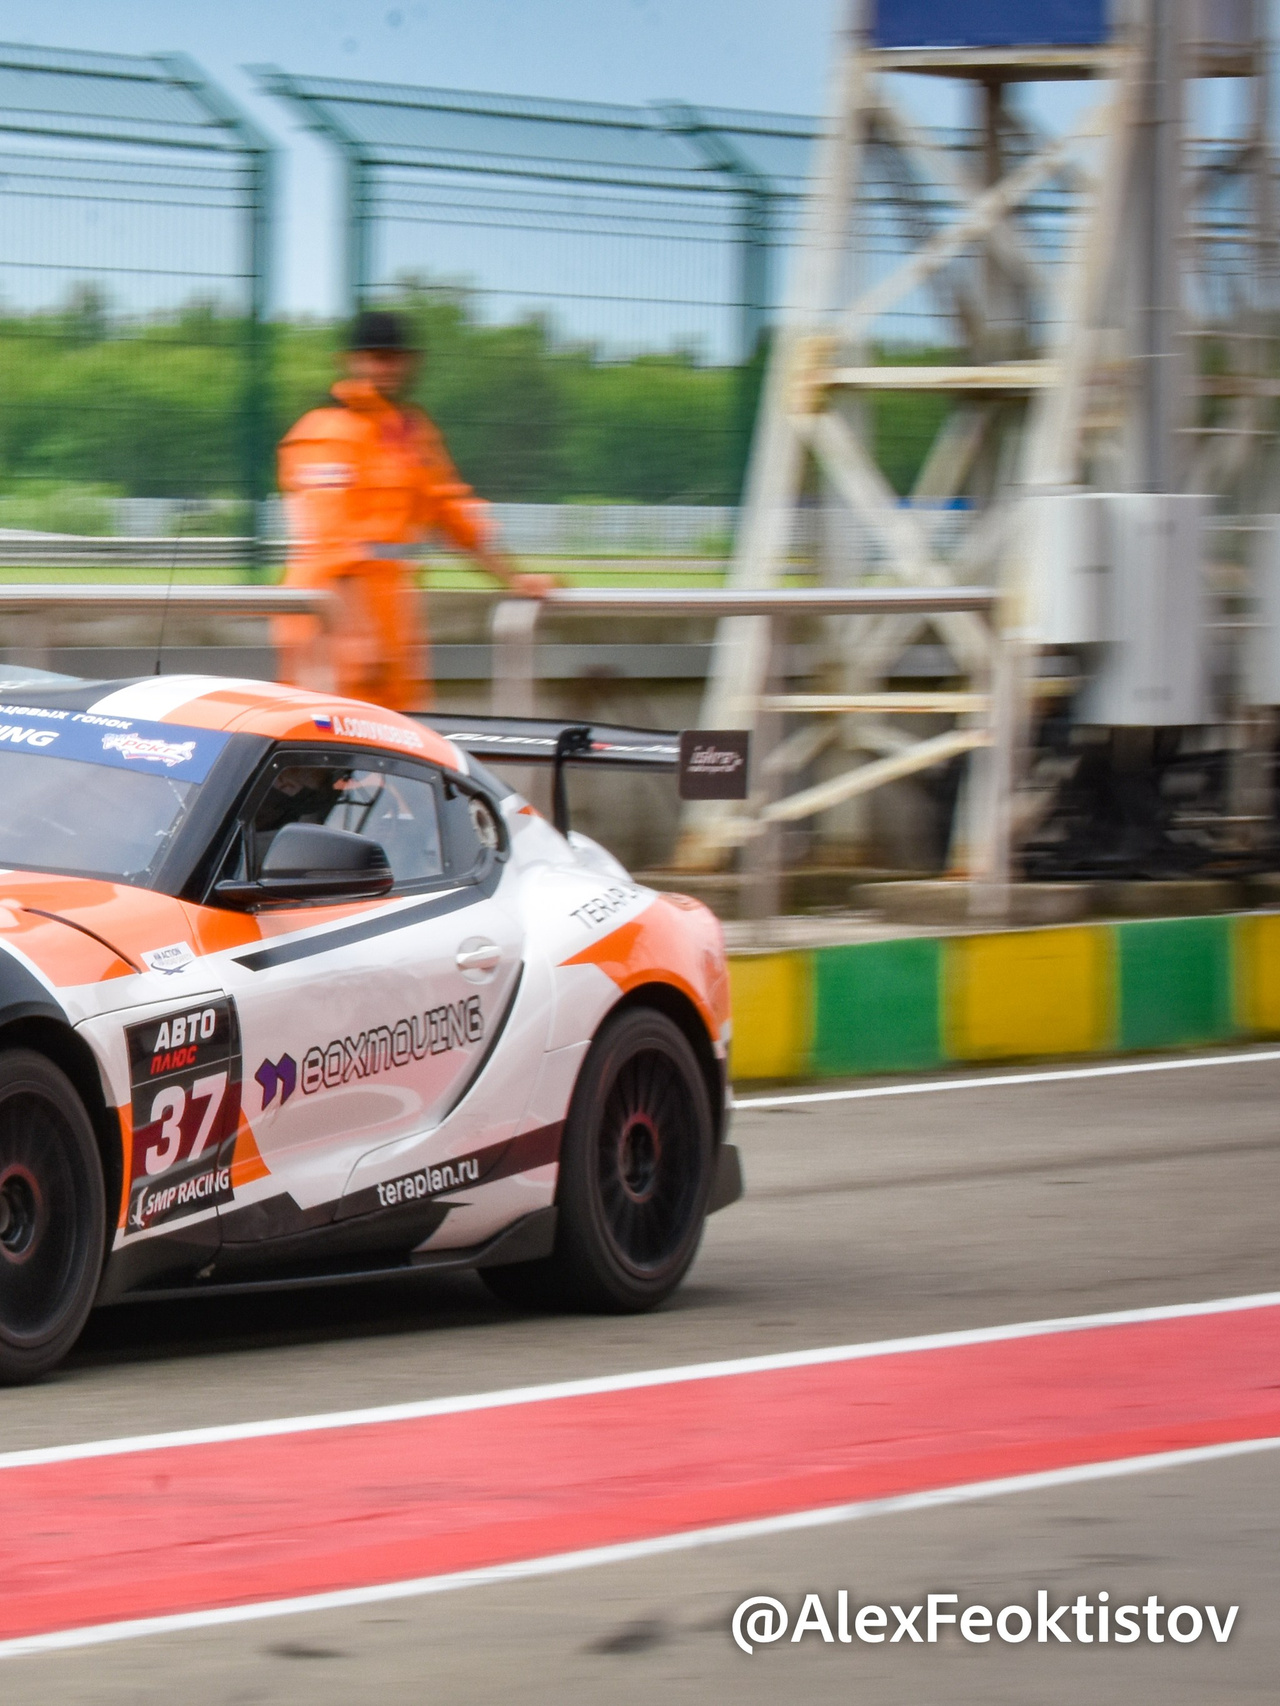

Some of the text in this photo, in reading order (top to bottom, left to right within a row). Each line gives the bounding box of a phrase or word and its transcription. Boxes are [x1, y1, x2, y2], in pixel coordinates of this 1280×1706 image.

[154, 1008, 216, 1053] АВТО
[150, 1045, 198, 1075] ПЛЮС
[145, 1071, 228, 1176] 37
[146, 1168, 229, 1215] SMP RACING
[376, 1158, 479, 1206] teraplan.ru
